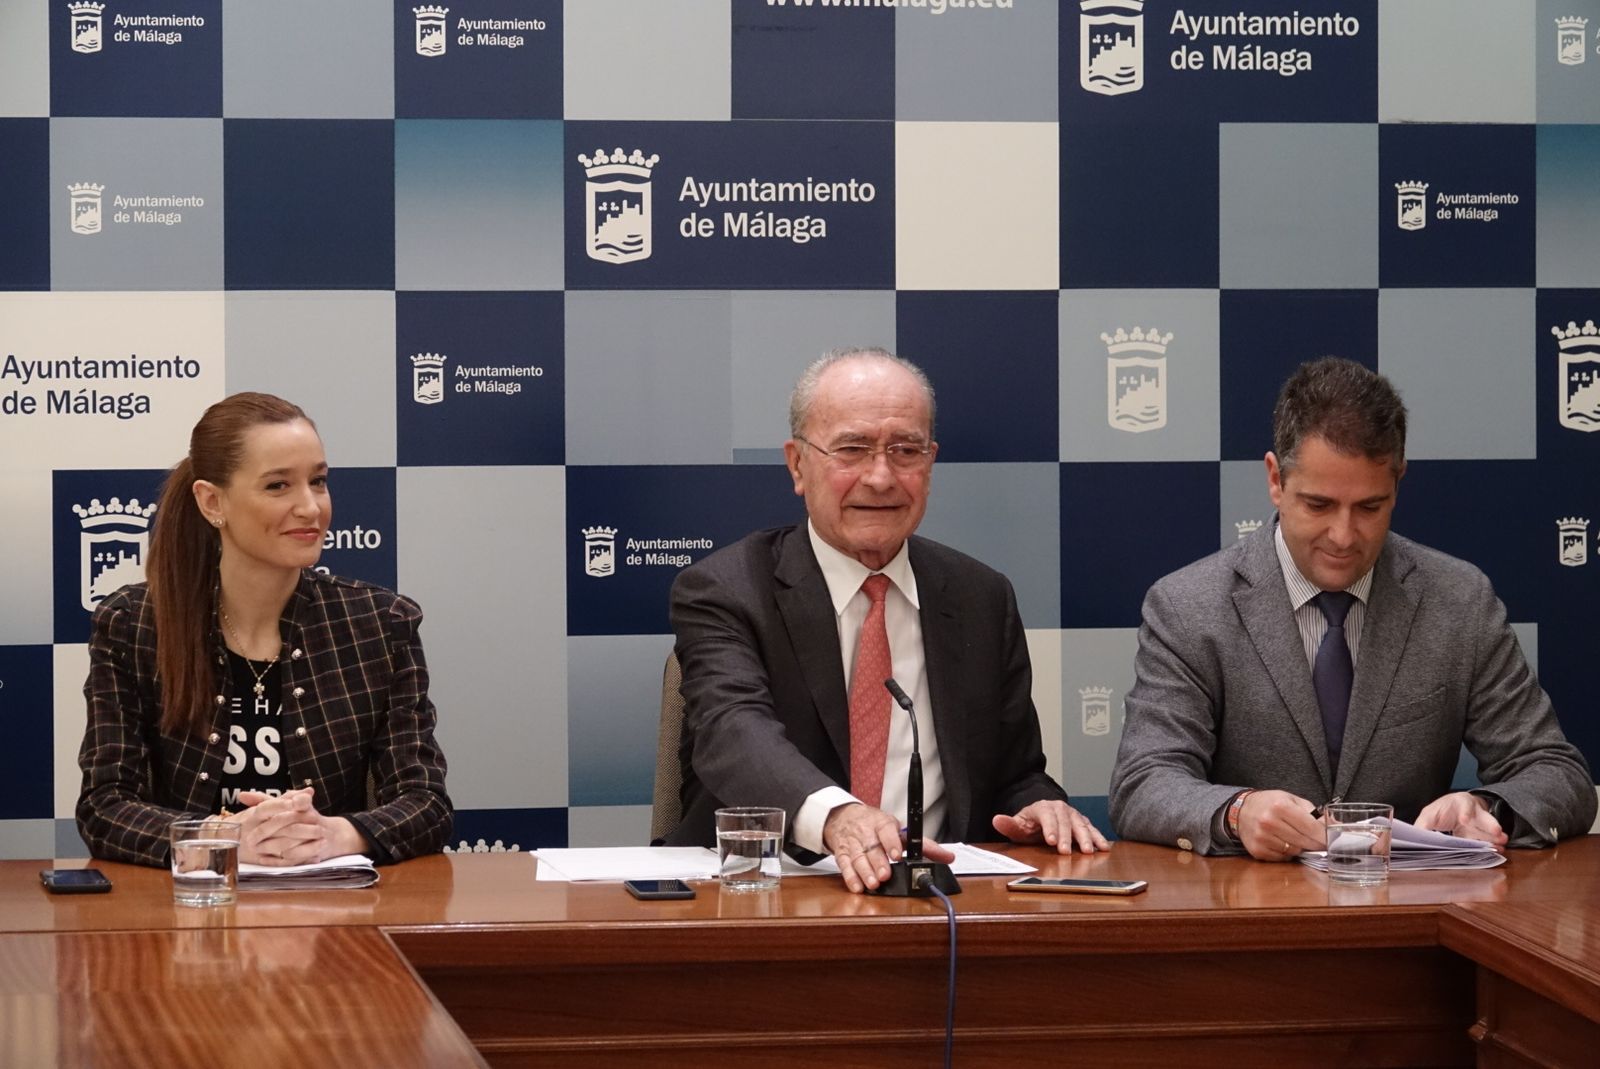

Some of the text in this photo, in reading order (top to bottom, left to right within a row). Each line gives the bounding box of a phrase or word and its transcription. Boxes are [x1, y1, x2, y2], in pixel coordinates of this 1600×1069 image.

[114, 13, 205, 29] Ayuntamiento
[457, 17, 546, 33] Ayuntamiento
[1169, 9, 1360, 41] Ayuntamiento
[114, 29, 182, 45] de Málaga
[457, 32, 524, 49] de Málaga
[1170, 43, 1312, 77] de Málaga
[678, 176, 876, 208] Ayuntamiento
[1436, 192, 1519, 207] Ayuntamiento
[113, 194, 205, 210] Ayuntamiento
[113, 210, 182, 226] de Málaga
[1436, 207, 1499, 222] de Málaga
[679, 210, 827, 244] de Málaga
[0, 354, 201, 385] Ayuntamiento
[454, 364, 544, 380] Ayuntamiento
[455, 380, 522, 395] de Málaga
[1, 388, 151, 420] de Málaga
[322, 524, 382, 550] ento
[625, 537, 714, 553] Ayuntamiento
[626, 552, 692, 568] de Málaga
[222, 724, 282, 776] SS
